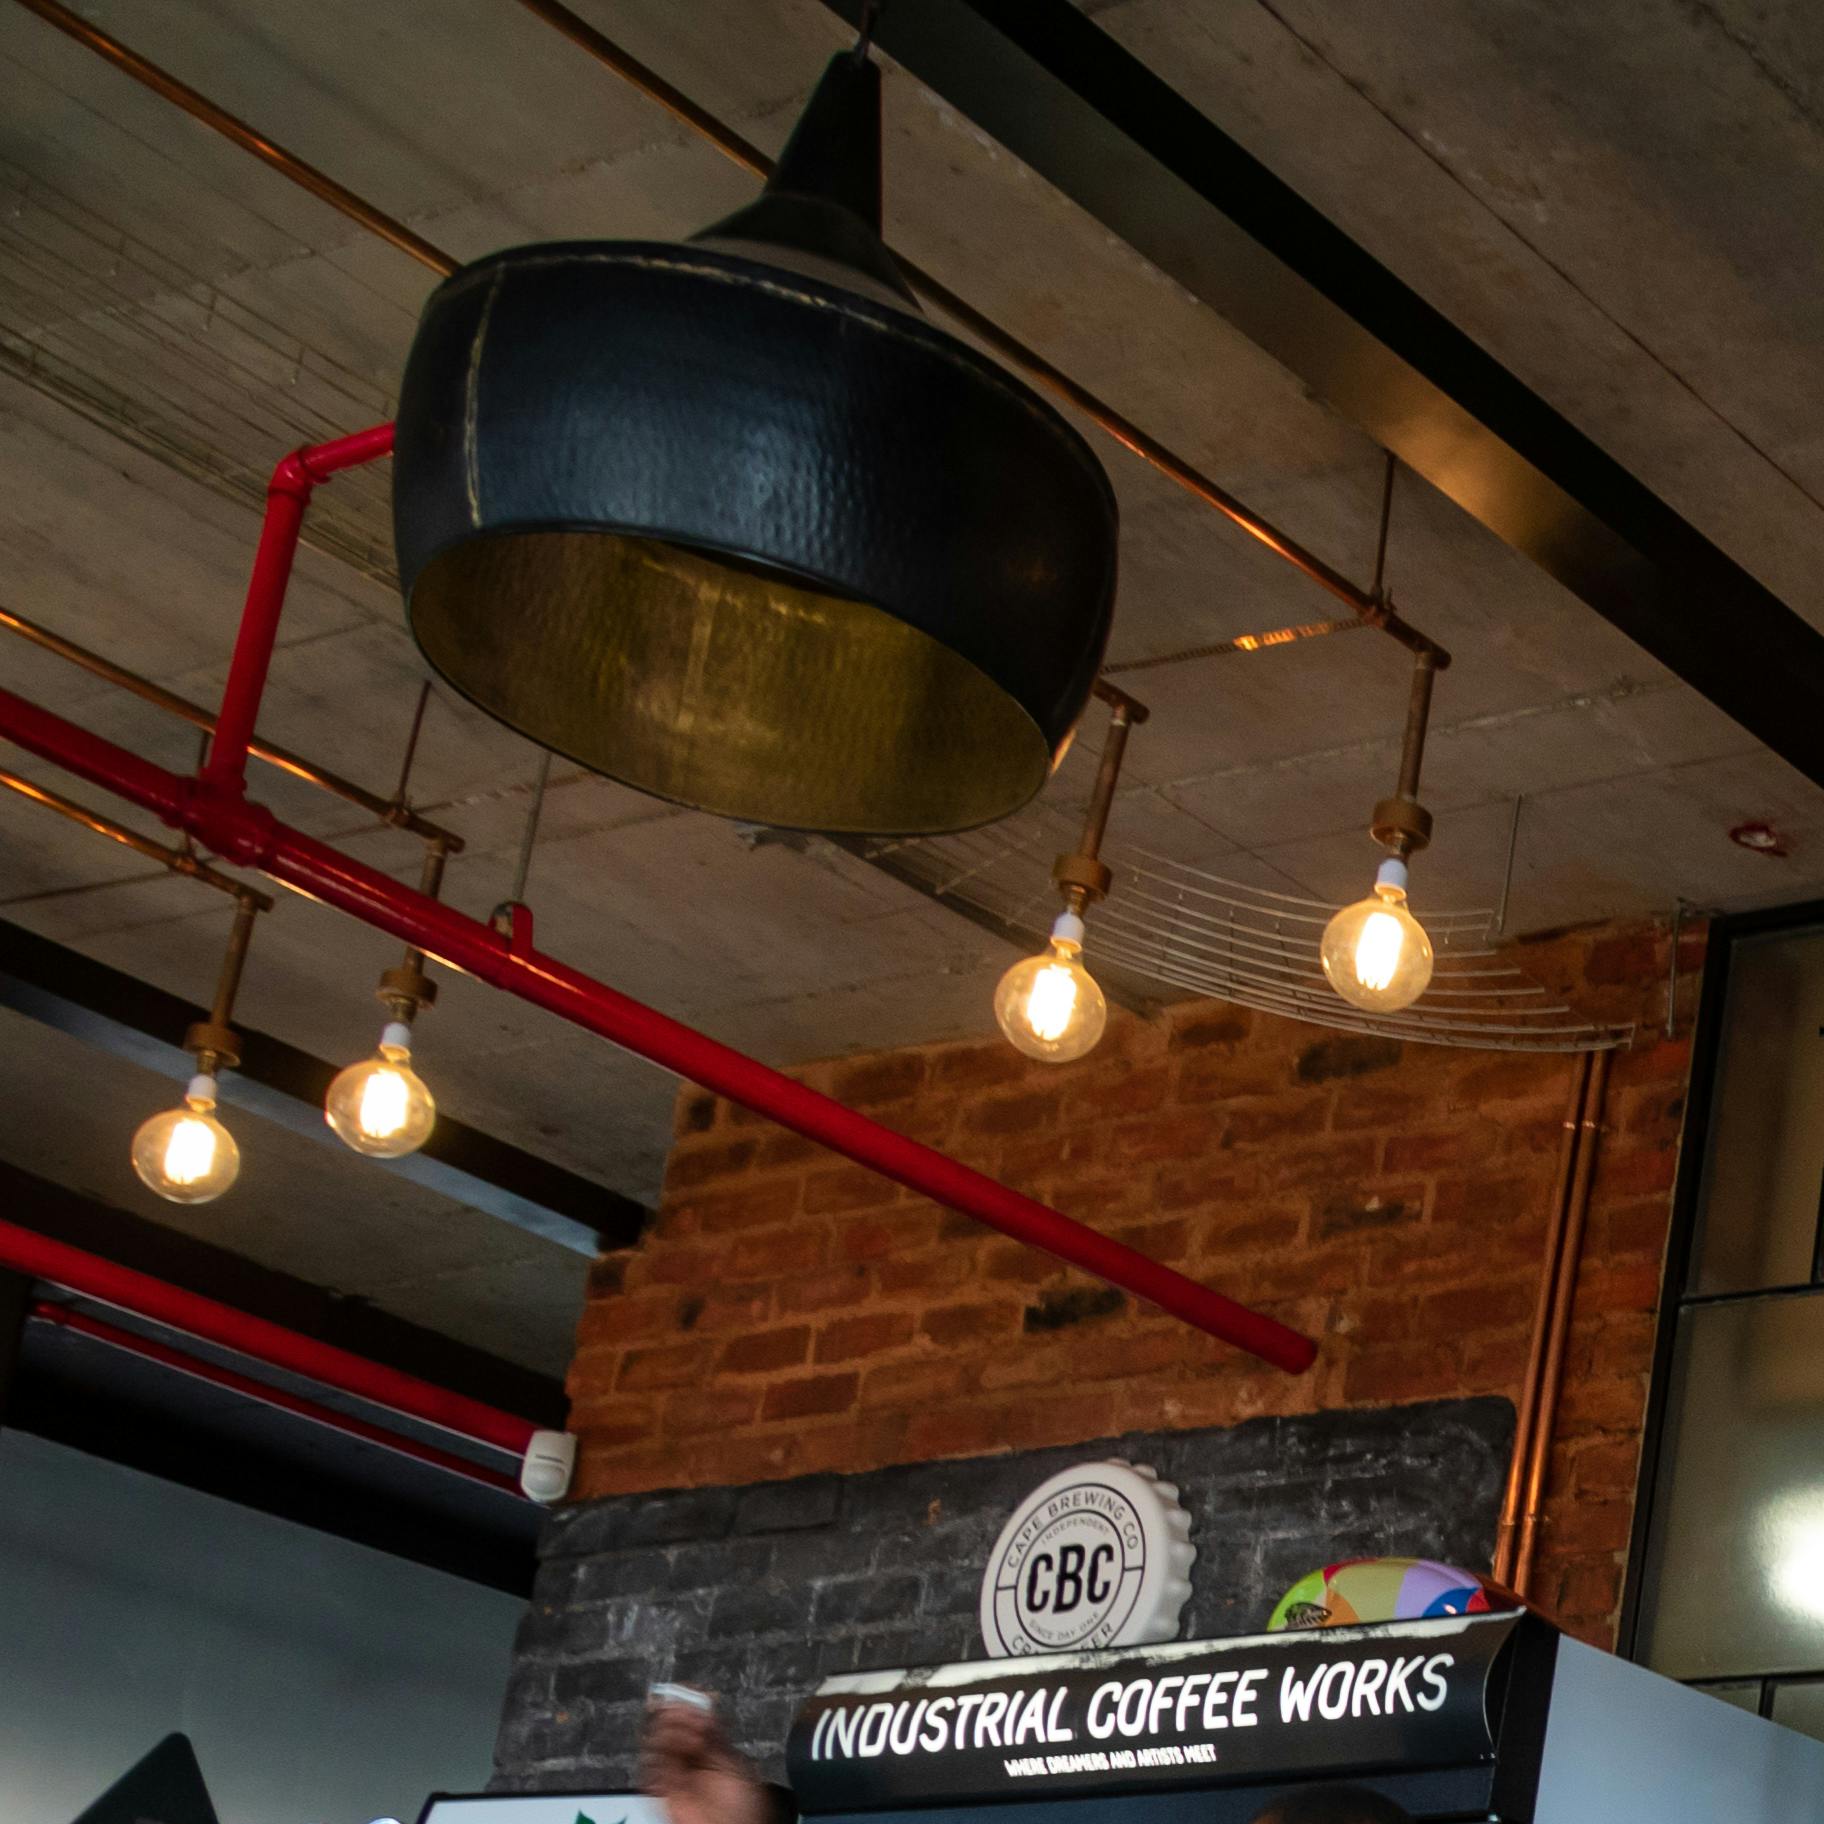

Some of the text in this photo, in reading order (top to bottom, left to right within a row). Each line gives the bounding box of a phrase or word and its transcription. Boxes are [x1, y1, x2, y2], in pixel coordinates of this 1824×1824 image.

[1007, 1490, 1139, 1569] CAPE BREWING CO
[1026, 1543, 1115, 1615] CBC
[811, 1653, 1455, 1760] INDUSTRIAL COFFEE WORKS
[1003, 1743, 1218, 1778] WHERE DREAMERS AND ARTISTS MEET
